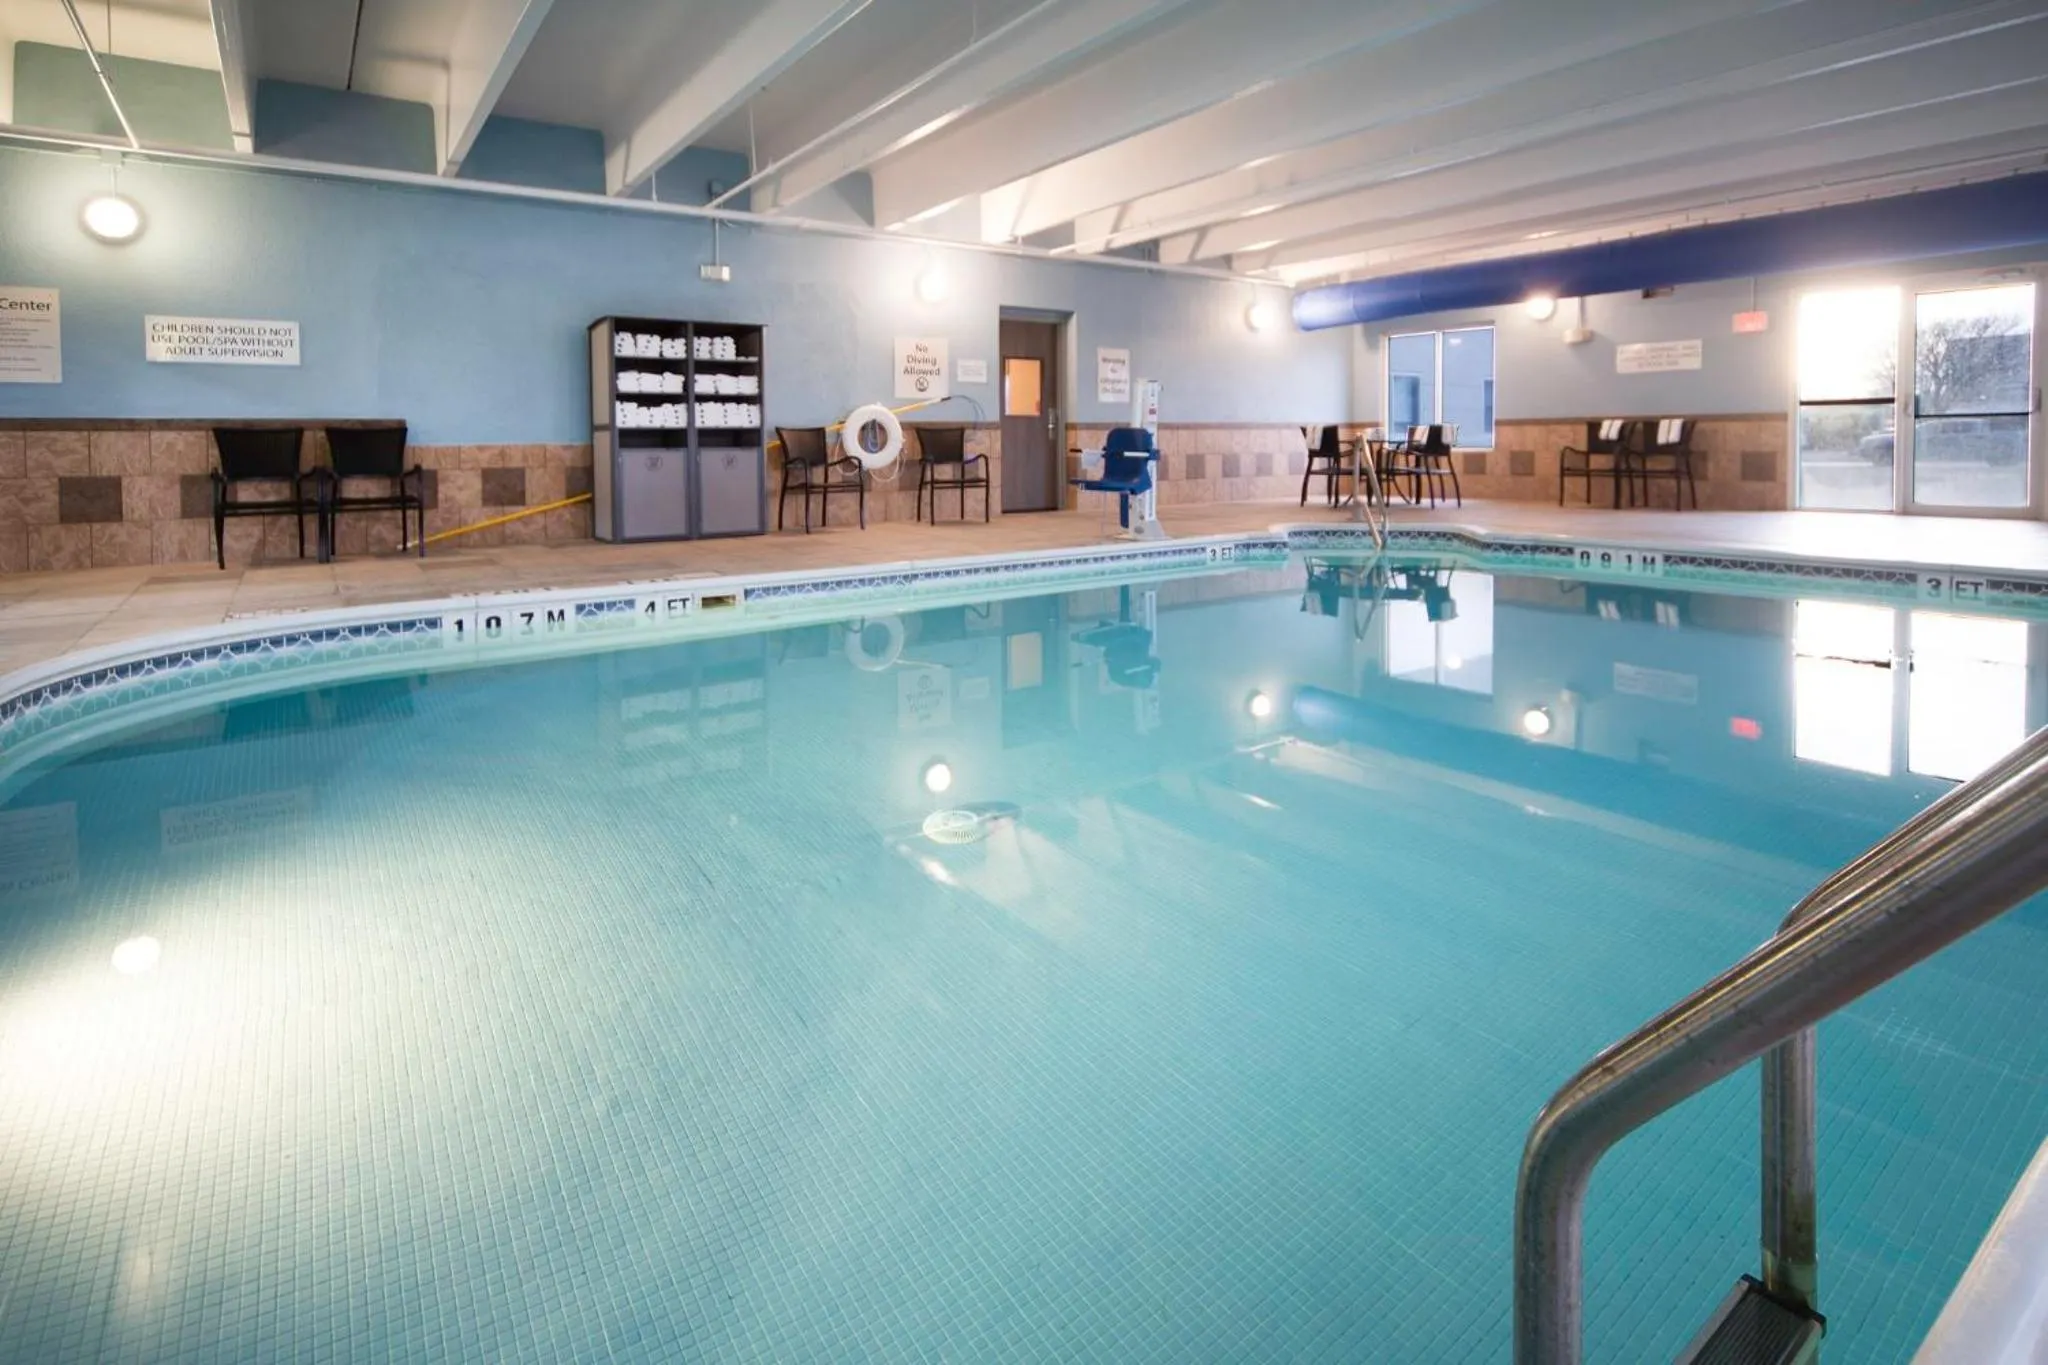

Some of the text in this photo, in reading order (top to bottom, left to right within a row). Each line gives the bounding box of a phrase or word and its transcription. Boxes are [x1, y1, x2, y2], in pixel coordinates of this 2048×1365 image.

[152, 323, 293, 337] CHILDREN SHOULD NOT
[151, 335, 295, 349] USE POOL/SPA WITHOUT
[165, 347, 284, 358] ADULT SUPERVISION
[915, 344, 928, 353] No
[906, 354, 937, 366] Diving
[903, 366, 941, 376] Allowed
